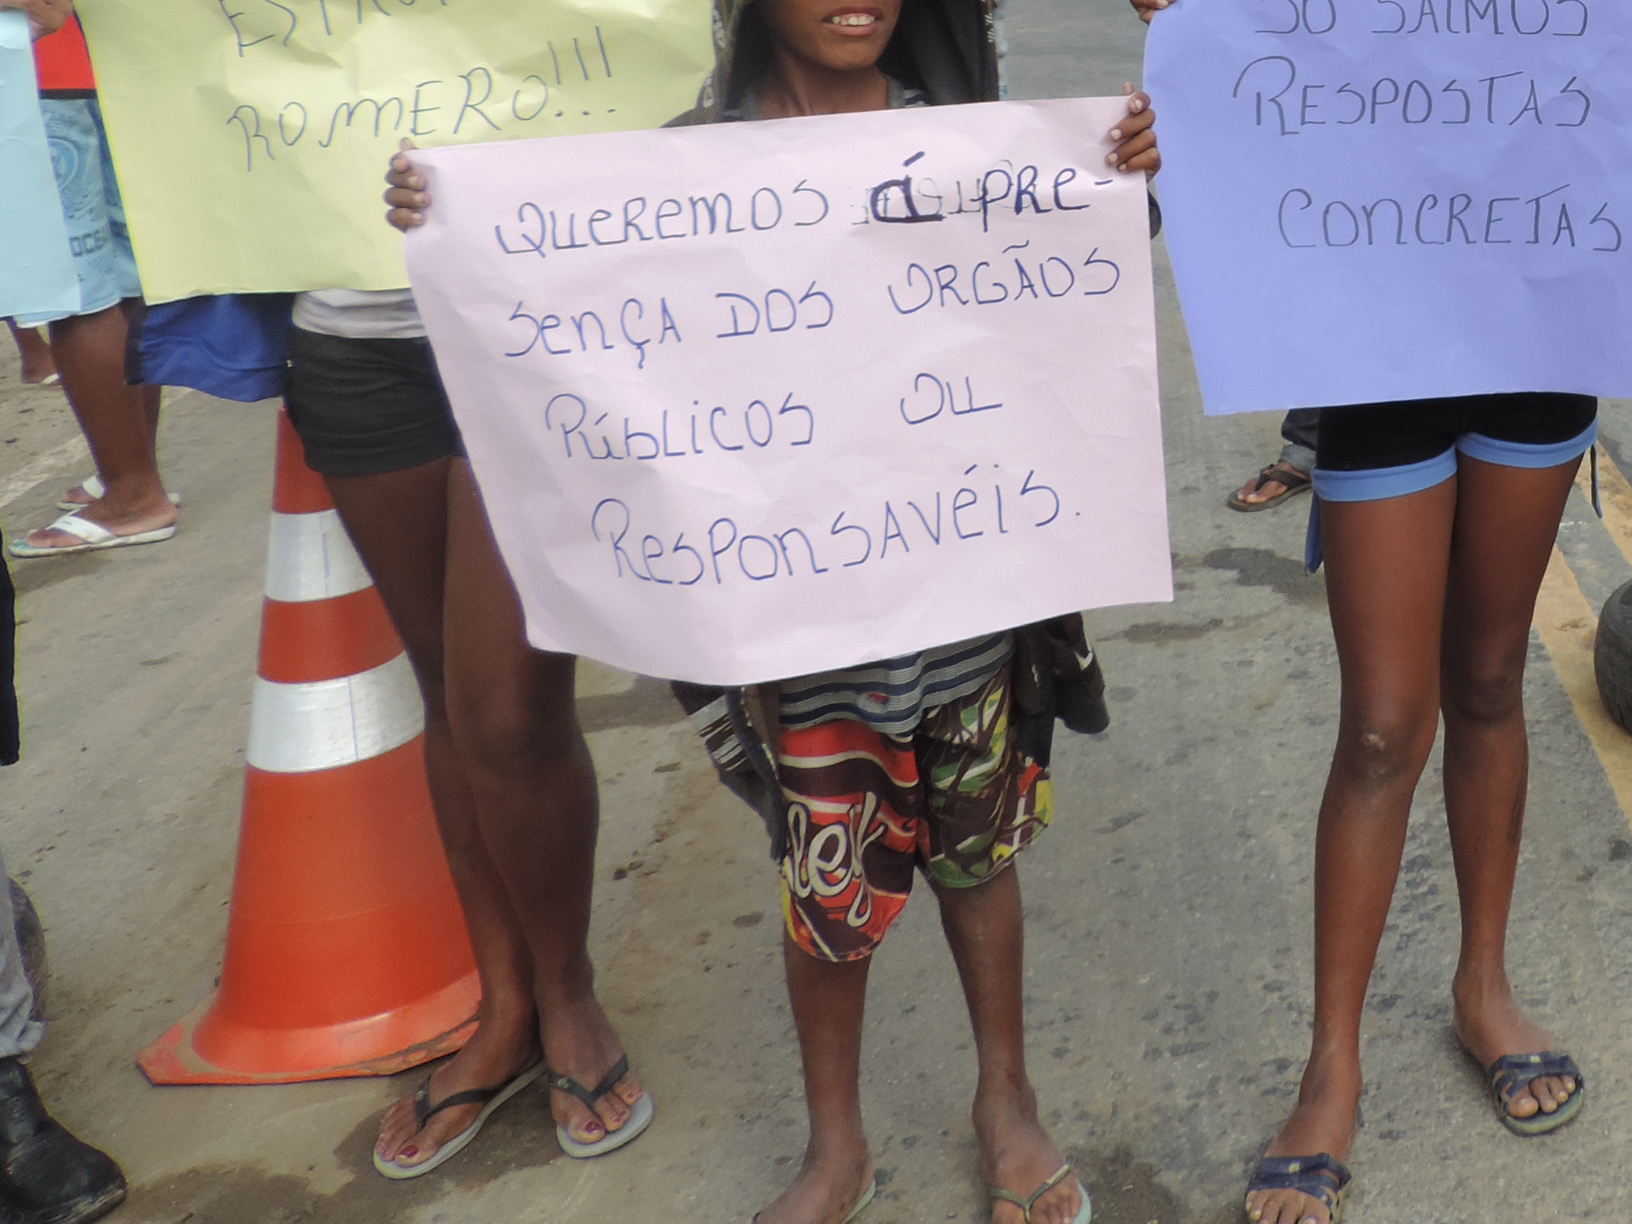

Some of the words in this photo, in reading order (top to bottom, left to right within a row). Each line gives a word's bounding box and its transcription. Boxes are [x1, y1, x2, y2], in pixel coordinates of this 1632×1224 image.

[1232, 55, 1593, 137] RESPOSTAS
[716, 279, 835, 341] DOS
[898, 371, 1004, 426] OU
